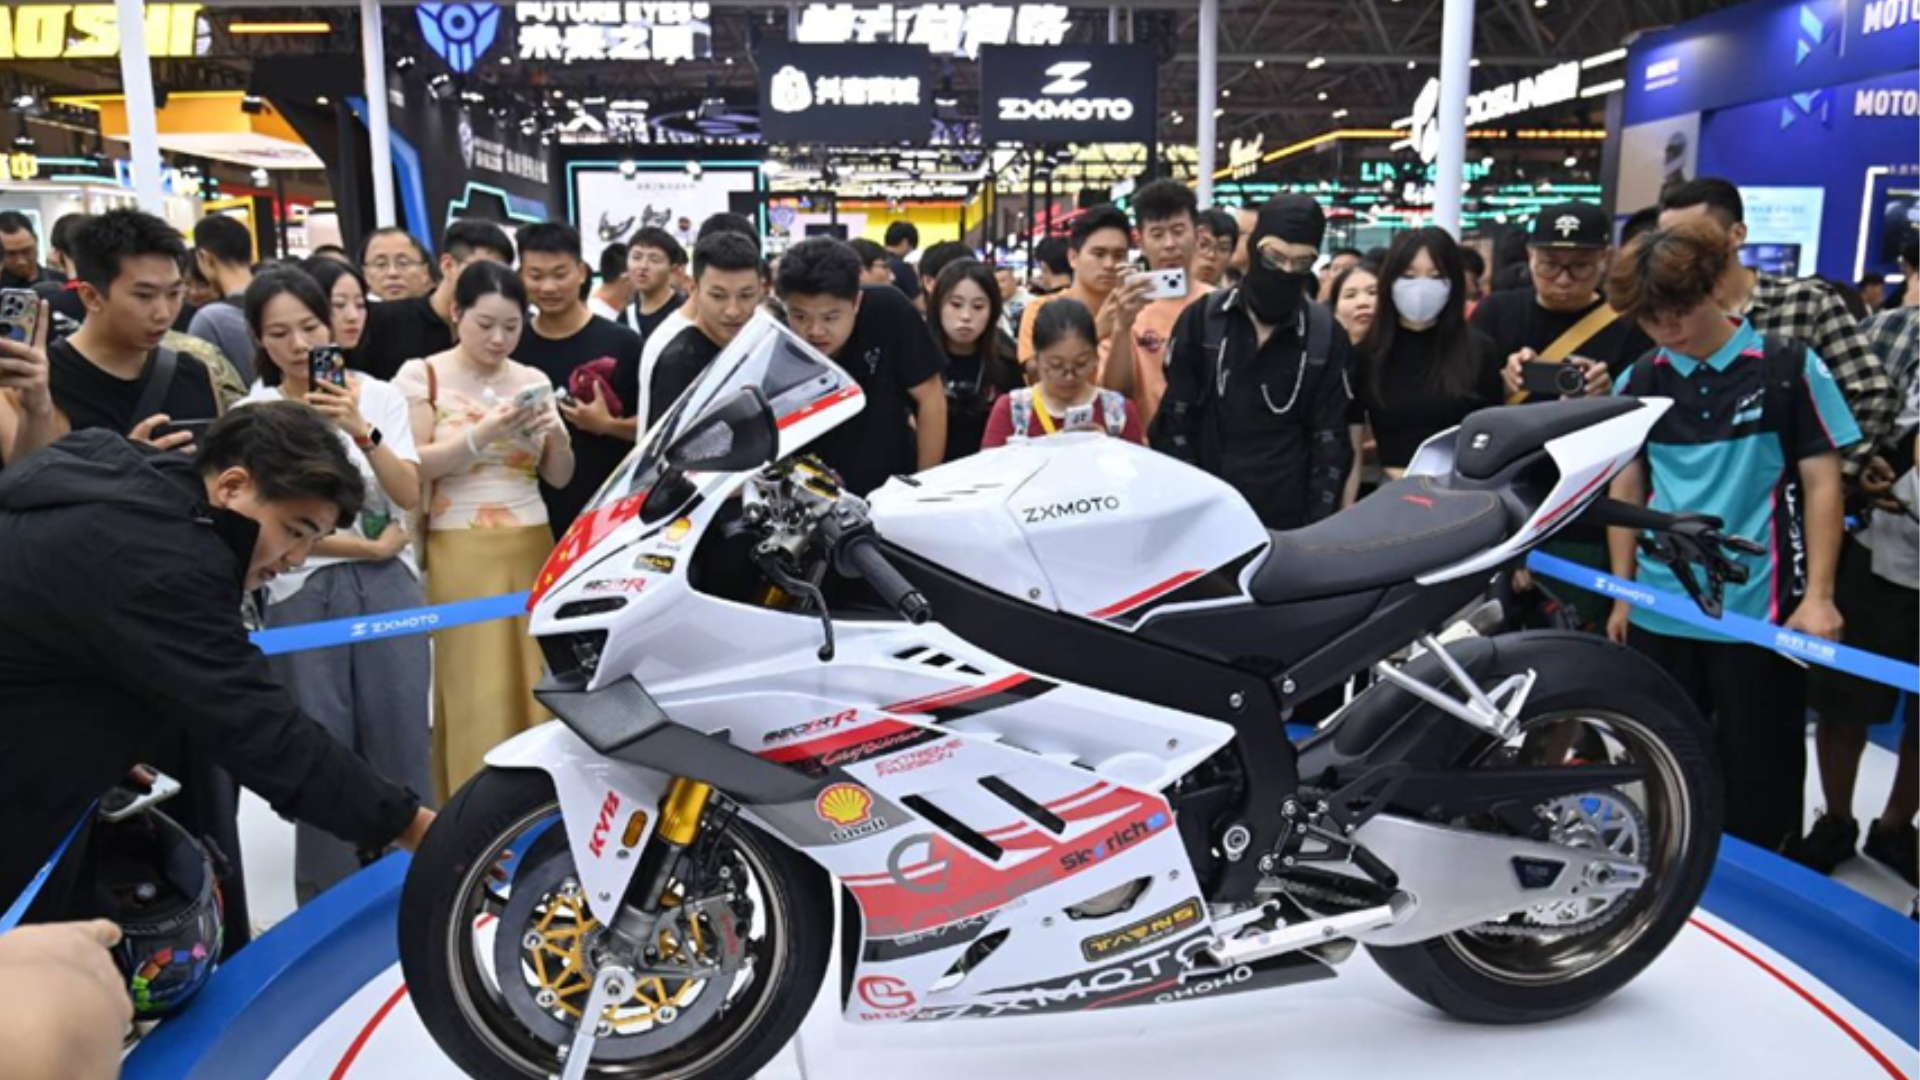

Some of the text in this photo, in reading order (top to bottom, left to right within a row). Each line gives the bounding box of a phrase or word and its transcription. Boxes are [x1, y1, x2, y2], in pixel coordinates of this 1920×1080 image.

[516, 2, 621, 22] FUTURE
[998, 98, 1134, 121] ZXMOTO
[1854, 89, 1919, 116] MOTO
[1022, 494, 1120, 524] ZXMOTO
[370, 613, 440, 634] ZXMOTO
[589, 790, 620, 858] KYB
[831, 817, 888, 842] Shell
